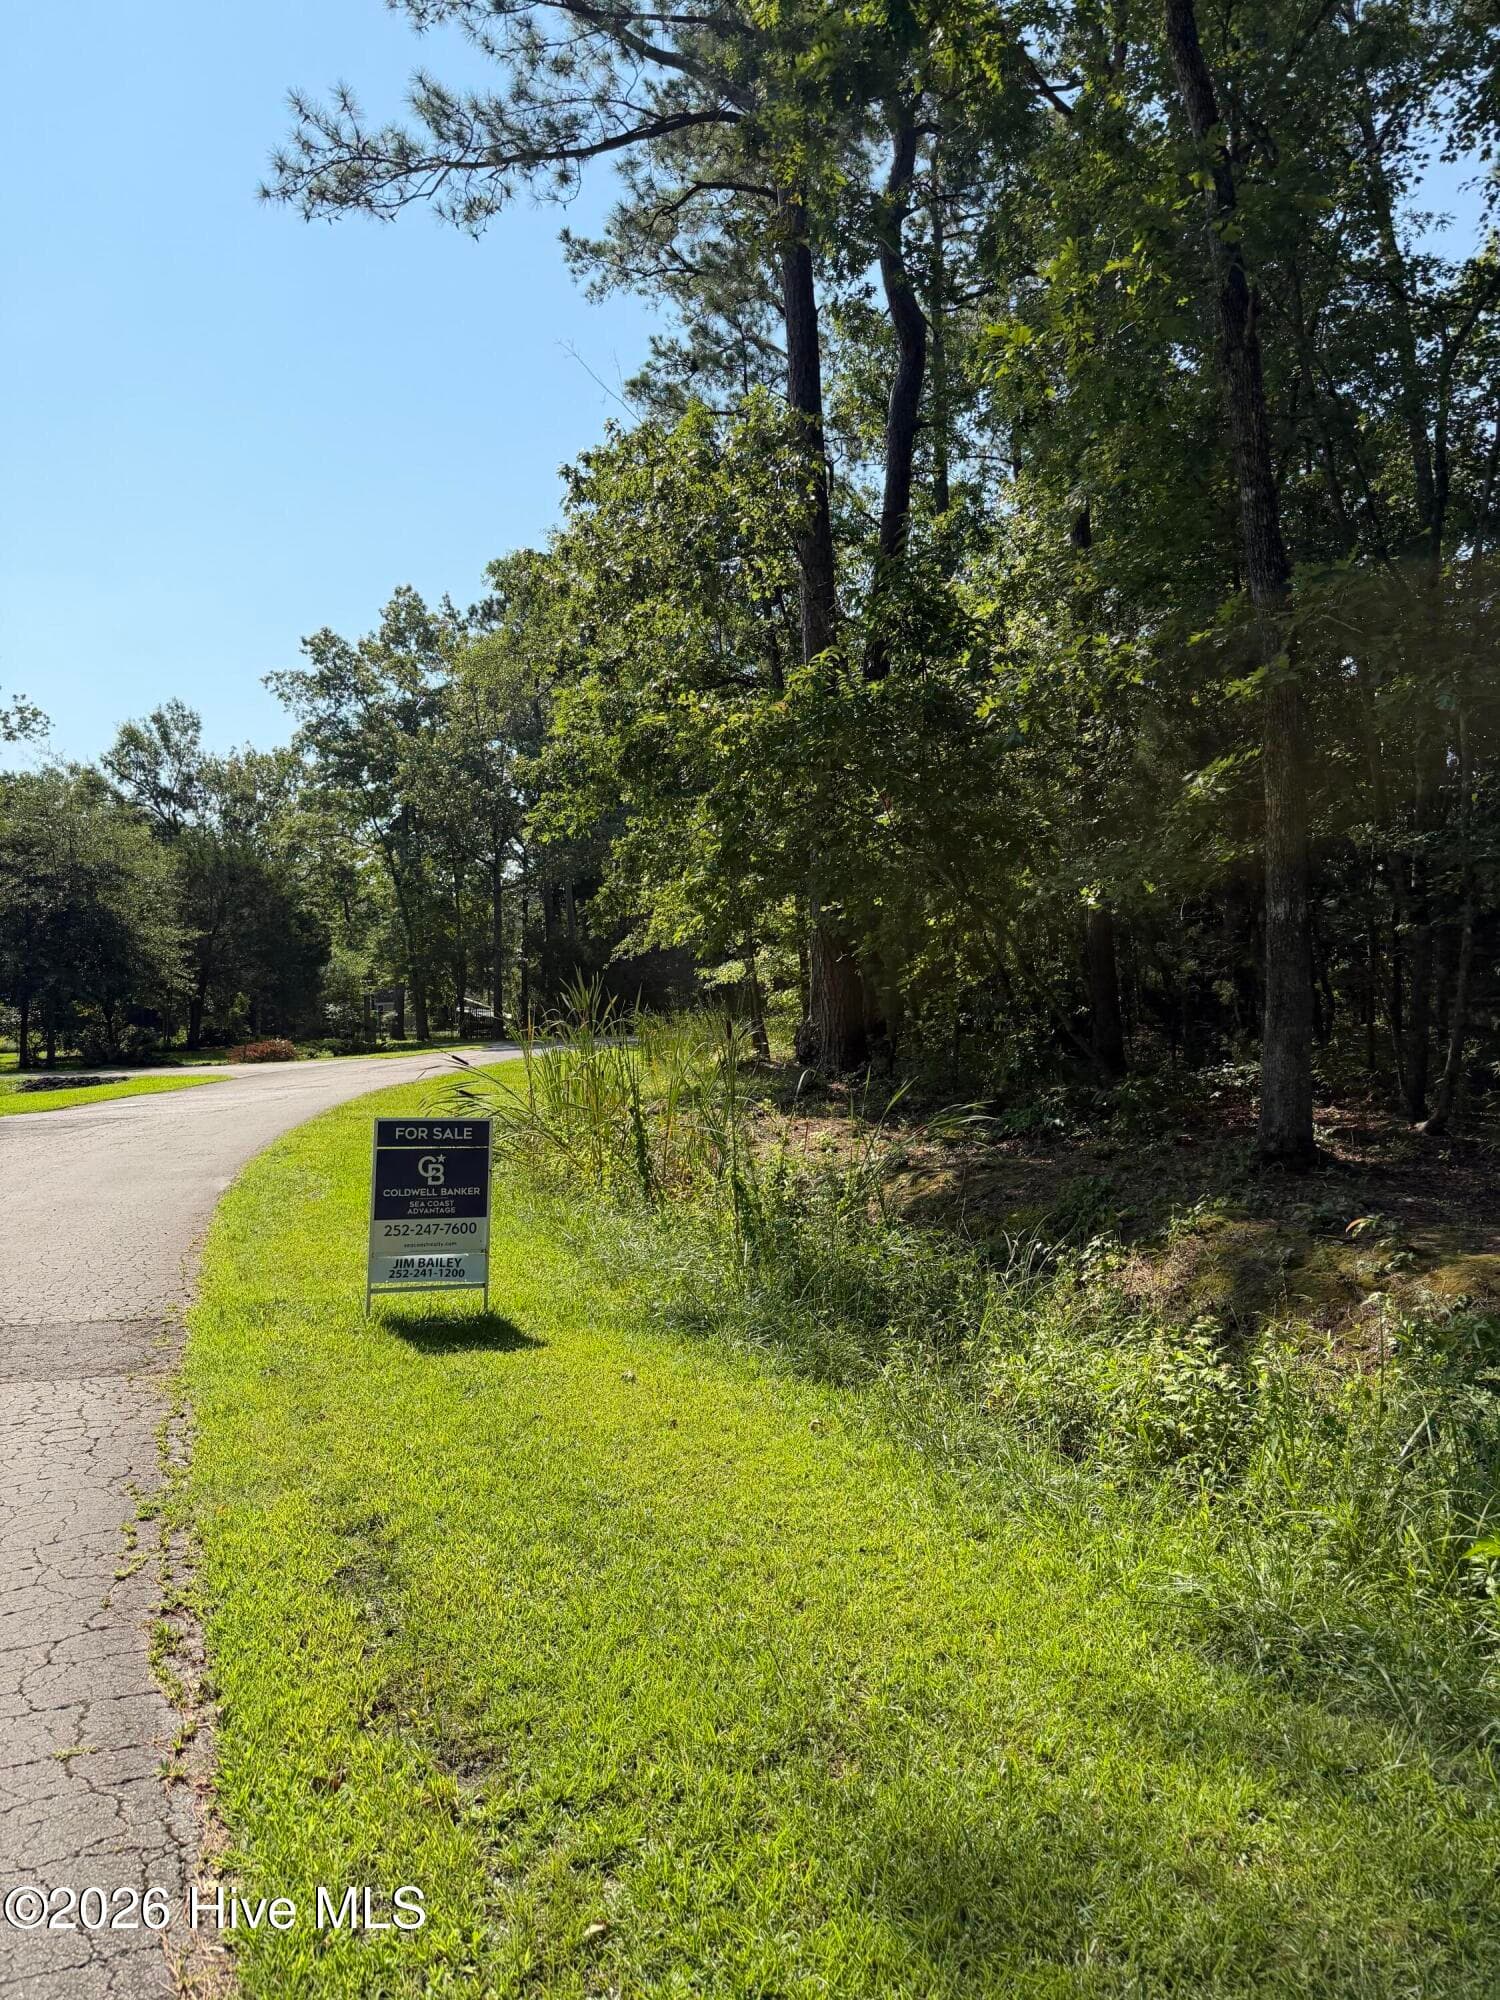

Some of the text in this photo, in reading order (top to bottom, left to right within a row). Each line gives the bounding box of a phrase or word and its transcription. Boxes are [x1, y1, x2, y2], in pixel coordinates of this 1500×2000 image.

[395, 1127, 473, 1140] FOR SALE
[383, 1187, 480, 1197] COLDWELL BANKER
[407, 1207, 456, 1215] ADVANTAGE
[384, 1222, 477, 1236] 252-247-7600
[393, 1257, 463, 1269] JIM BAILEY
[388, 1268, 465, 1279] 252-241-1200
